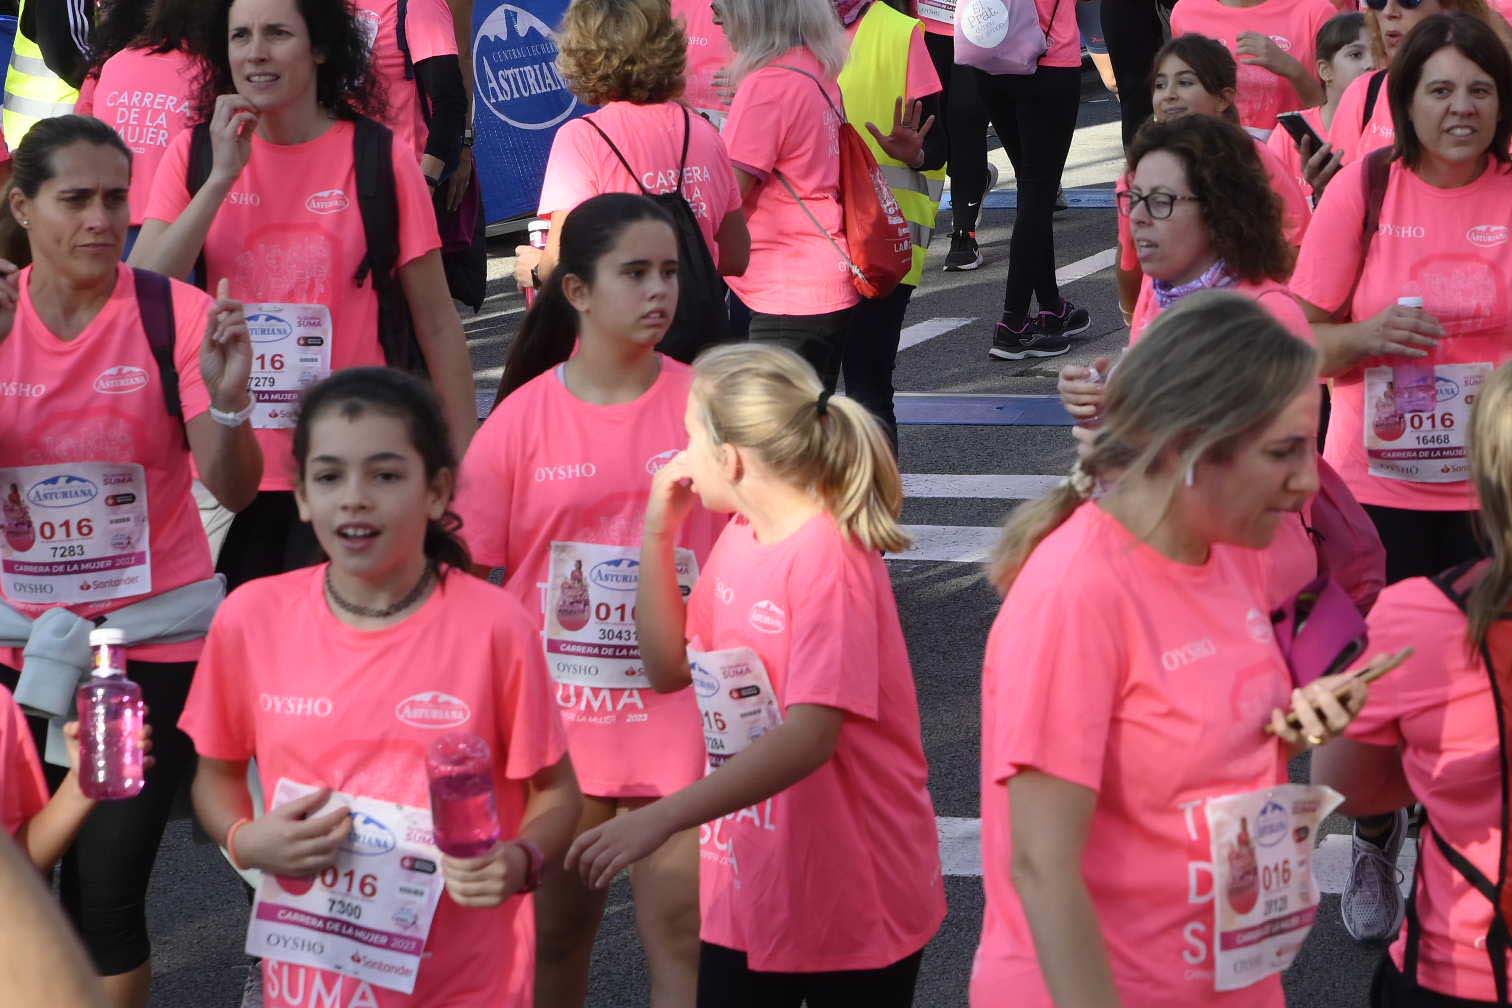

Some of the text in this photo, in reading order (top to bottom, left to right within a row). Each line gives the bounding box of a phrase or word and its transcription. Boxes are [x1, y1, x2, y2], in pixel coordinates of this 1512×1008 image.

[492, 47, 527, 65] CENTRAL
[106, 89, 193, 118] CARRERA
[117, 109, 169, 129] DE LA
[248, 325, 289, 337] TURIANA
[255, 353, 285, 371] 16
[1409, 411, 1455, 430] 016
[1415, 433, 1451, 447] 16468
[534, 462, 597, 482] OYSHO
[103, 476, 135, 487] SUMA
[34, 486, 95, 503] ASTURIANA
[39, 517, 95, 541] 016
[50, 544, 85, 558] 7283
[14, 561, 52, 573] CARRERA
[66, 561, 80, 572] LA
[80, 559, 113, 571] MUJER
[13, 582, 54, 595] OYSHO
[91, 575, 142, 590] Santander
[559, 642, 600, 655] CARRERA
[555, 661, 600, 677] OYSHO
[260, 693, 334, 718] OYSHO
[319, 866, 380, 898] 016
[1263, 859, 1292, 894] 016
[265, 933, 326, 957] OYSHO
